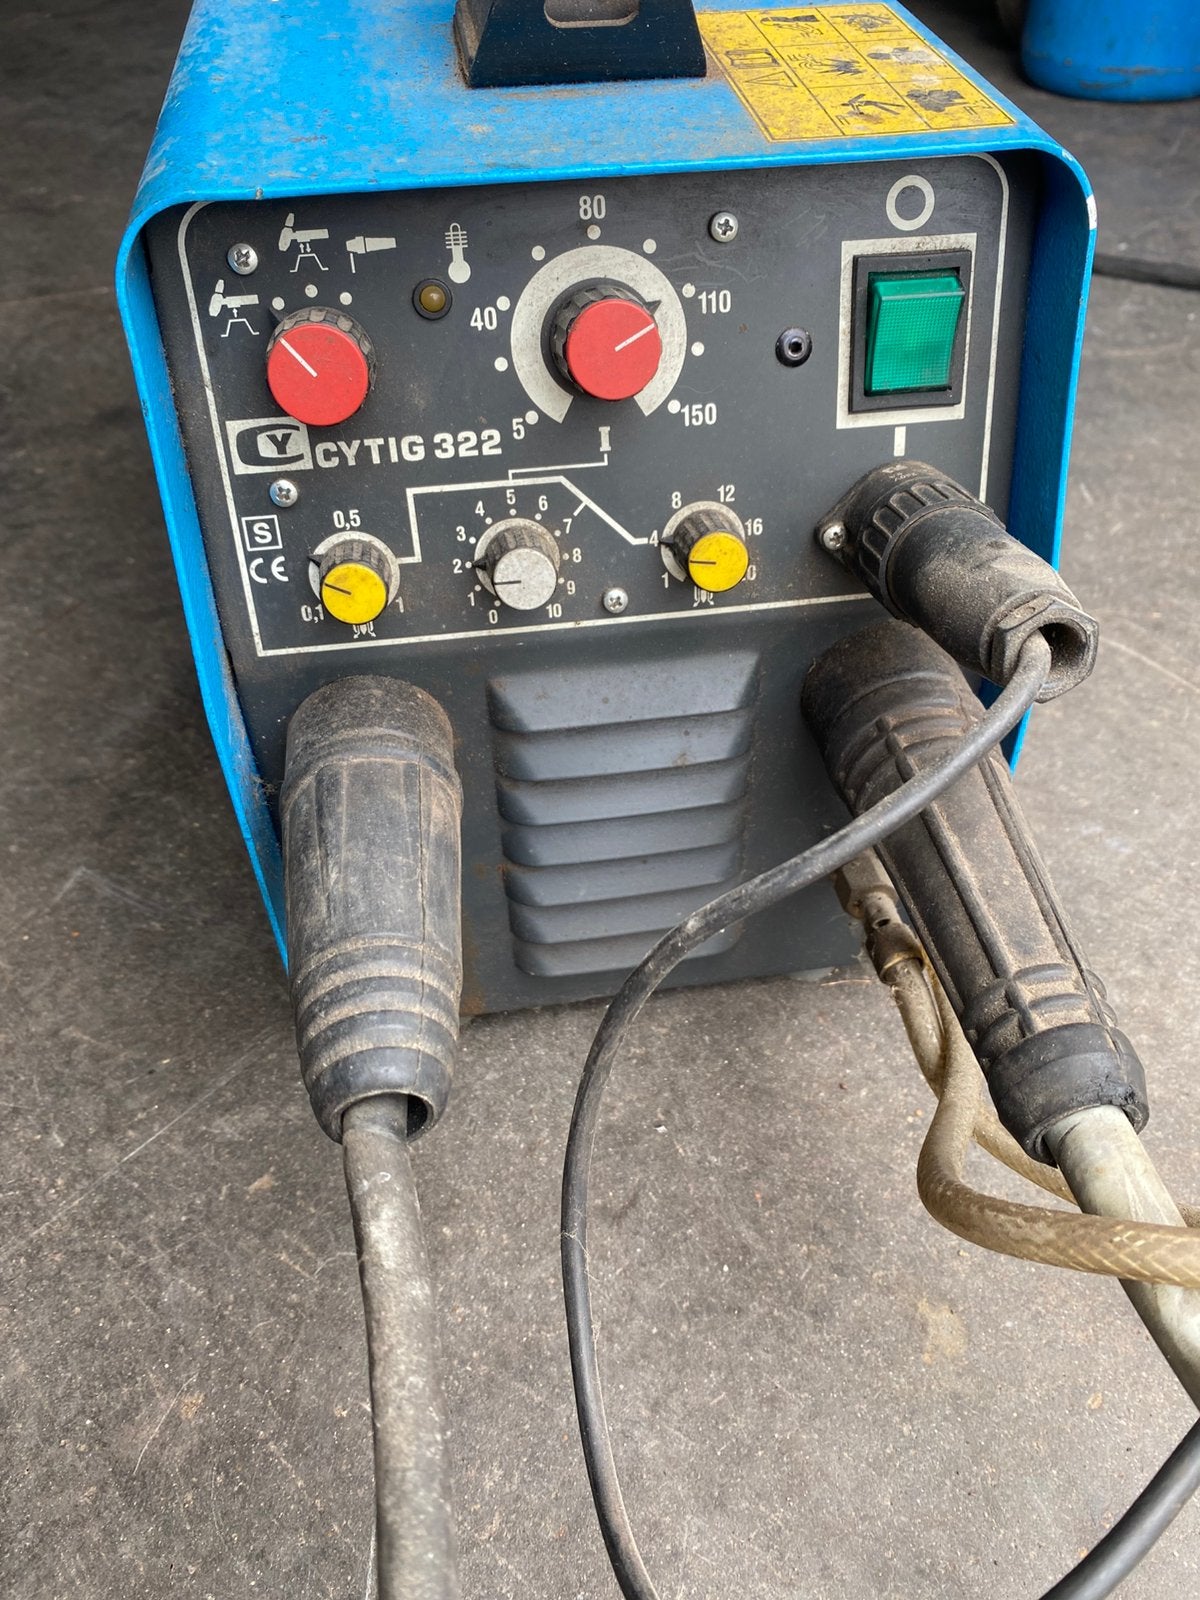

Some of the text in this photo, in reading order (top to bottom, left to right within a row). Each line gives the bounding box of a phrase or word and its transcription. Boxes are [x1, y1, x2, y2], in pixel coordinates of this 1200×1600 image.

[579, 194, 606, 220] 80
[697, 290, 732, 315] 110
[469, 307, 498, 332] 40
[680, 403, 718, 428] 150
[511, 418, 526, 441] 5
[315, 429, 503, 469] CYTIG 322
[505, 489, 517, 506] 5
[671, 491, 683, 509] 8
[717, 484, 736, 503] 12
[474, 501, 486, 517] 4
[538, 495, 549, 512] 6
[332, 509, 362, 532] 0,5
[562, 518, 574, 535] 7
[745, 518, 764, 537] 16
[252, 522, 274, 544] S
[455, 526, 467, 542] 3
[647, 530, 659, 547] 4
[572, 546, 583, 563] 8
[452, 559, 463, 574] 2
[565, 580, 577, 597] 9
[661, 572, 669, 589] 1
[395, 597, 405, 614] 1
[467, 591, 475, 607] 1
[300, 604, 325, 624] 0,1
[488, 609, 499, 625] 0
[546, 602, 563, 619] 10
